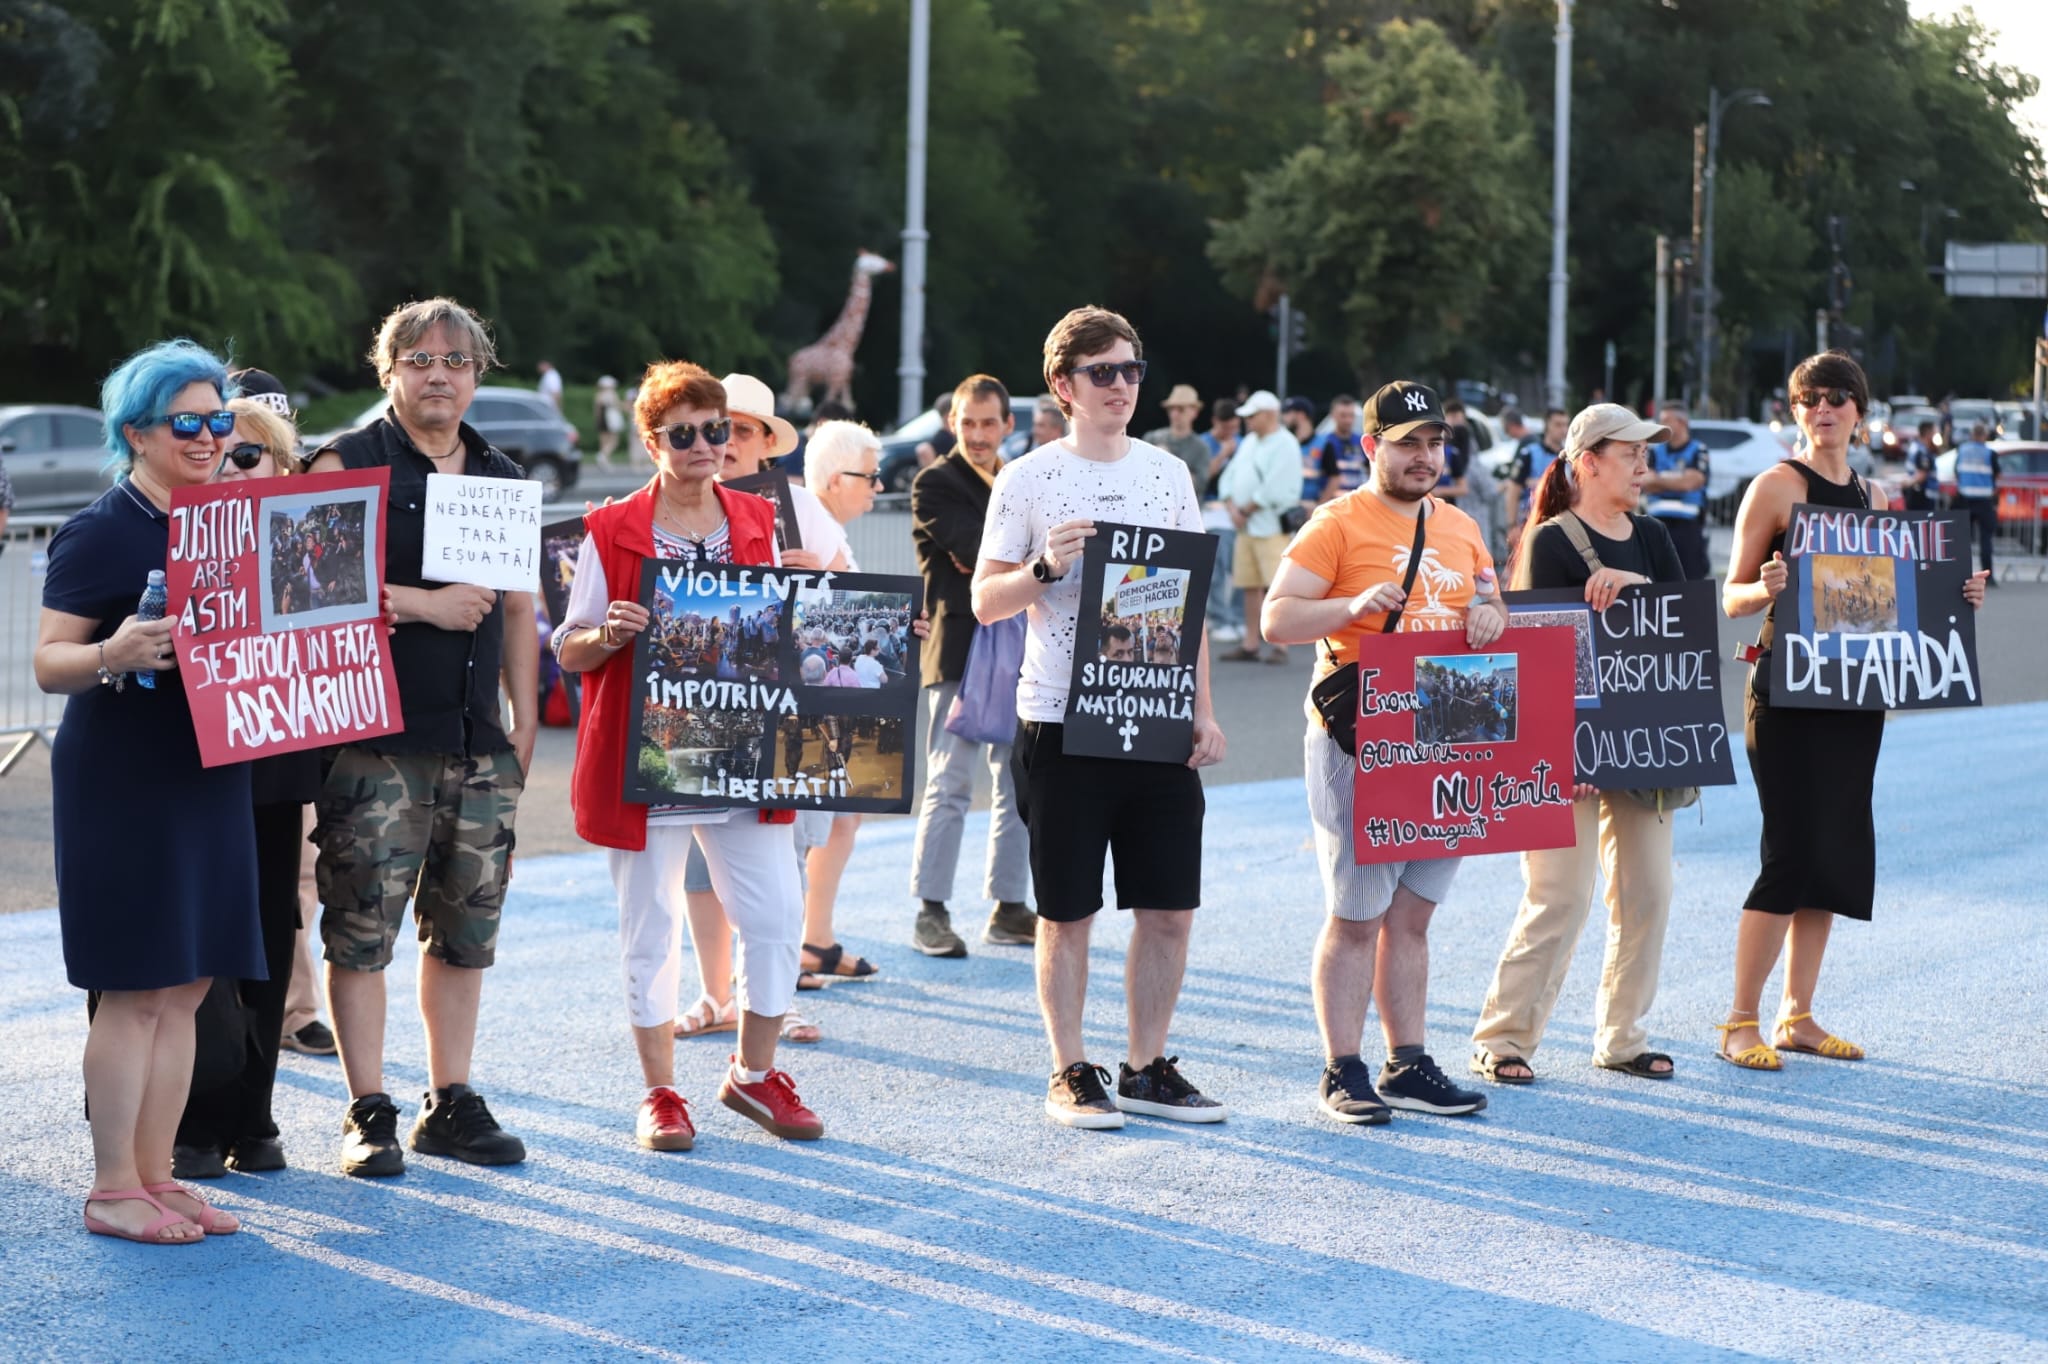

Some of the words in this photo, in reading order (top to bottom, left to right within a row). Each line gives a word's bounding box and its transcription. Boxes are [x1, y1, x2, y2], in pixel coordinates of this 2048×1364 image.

[1404, 390, 1428, 411] NY
[1111, 527, 1165, 560] RIP
[1119, 577, 1180, 599] DEMOCRACY
[1145, 588, 1180, 604] HACKED
[1601, 588, 1685, 639] CINE
[1597, 650, 1714, 694] RĂSPUNDE
[1785, 631, 1832, 695] DE
[1432, 771, 1483, 820] NU
